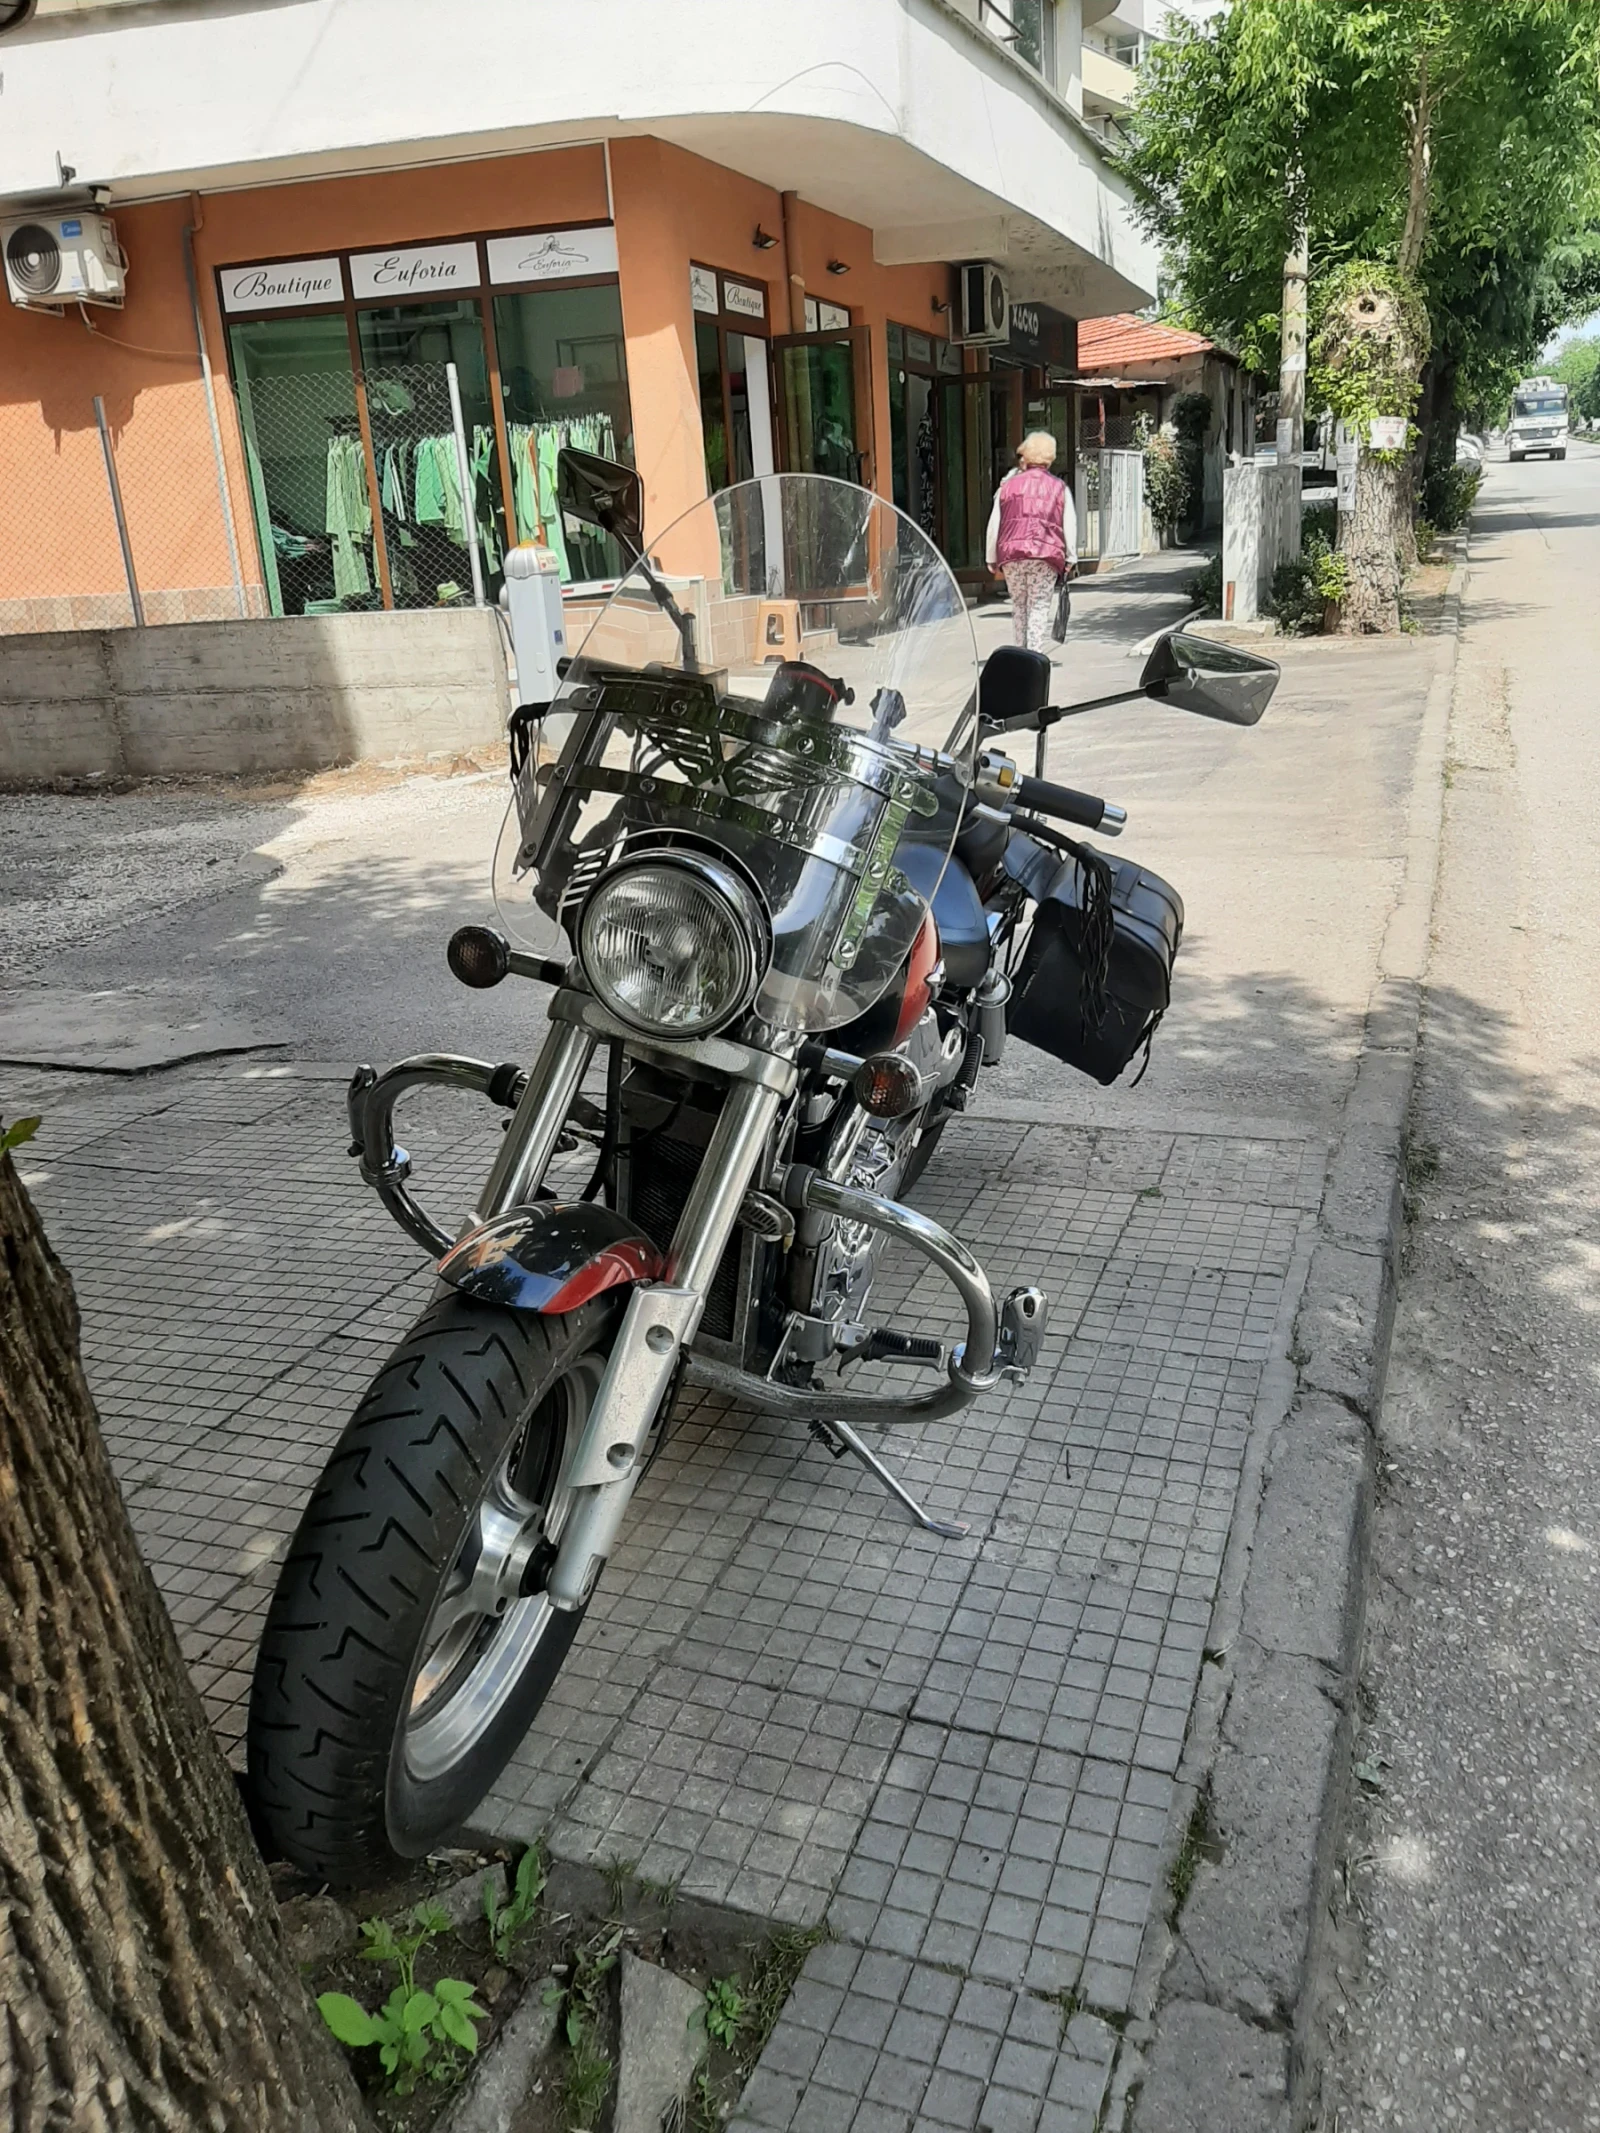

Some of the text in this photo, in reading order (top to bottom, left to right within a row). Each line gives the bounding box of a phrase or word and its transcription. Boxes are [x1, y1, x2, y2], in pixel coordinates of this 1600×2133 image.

[233, 256, 457, 299] Boutique Euforia
[727, 286, 762, 314] Boutique
